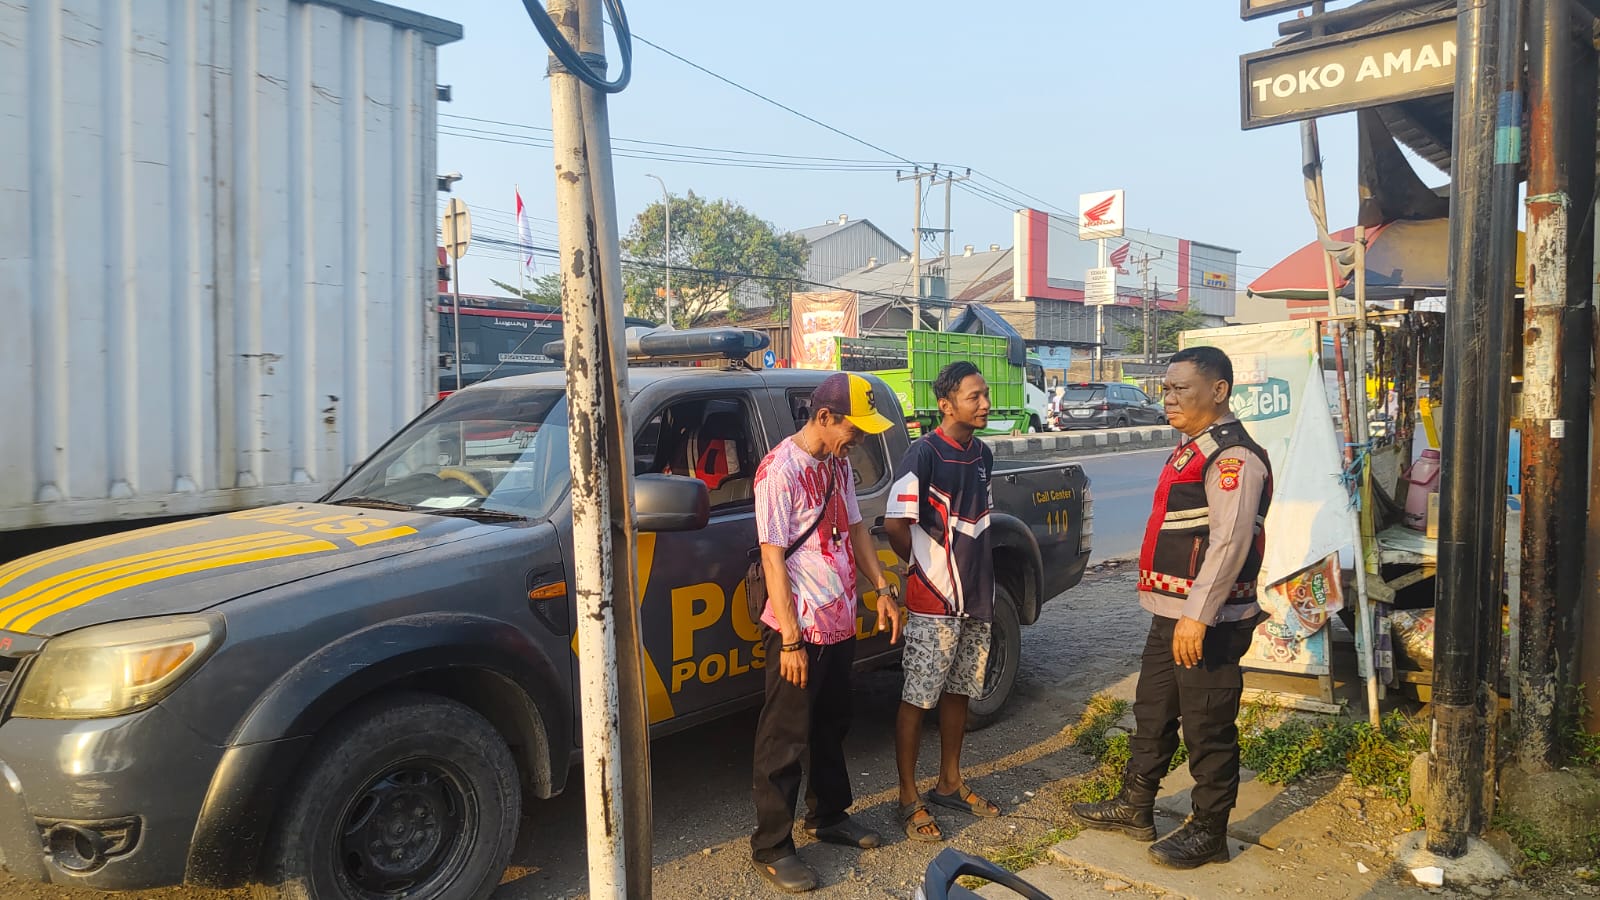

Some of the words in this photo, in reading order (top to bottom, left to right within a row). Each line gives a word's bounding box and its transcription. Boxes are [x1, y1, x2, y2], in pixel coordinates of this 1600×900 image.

[1253, 63, 1345, 102] TOKO
[1083, 218, 1116, 229] HONDA
[1046, 509, 1068, 536] 110
